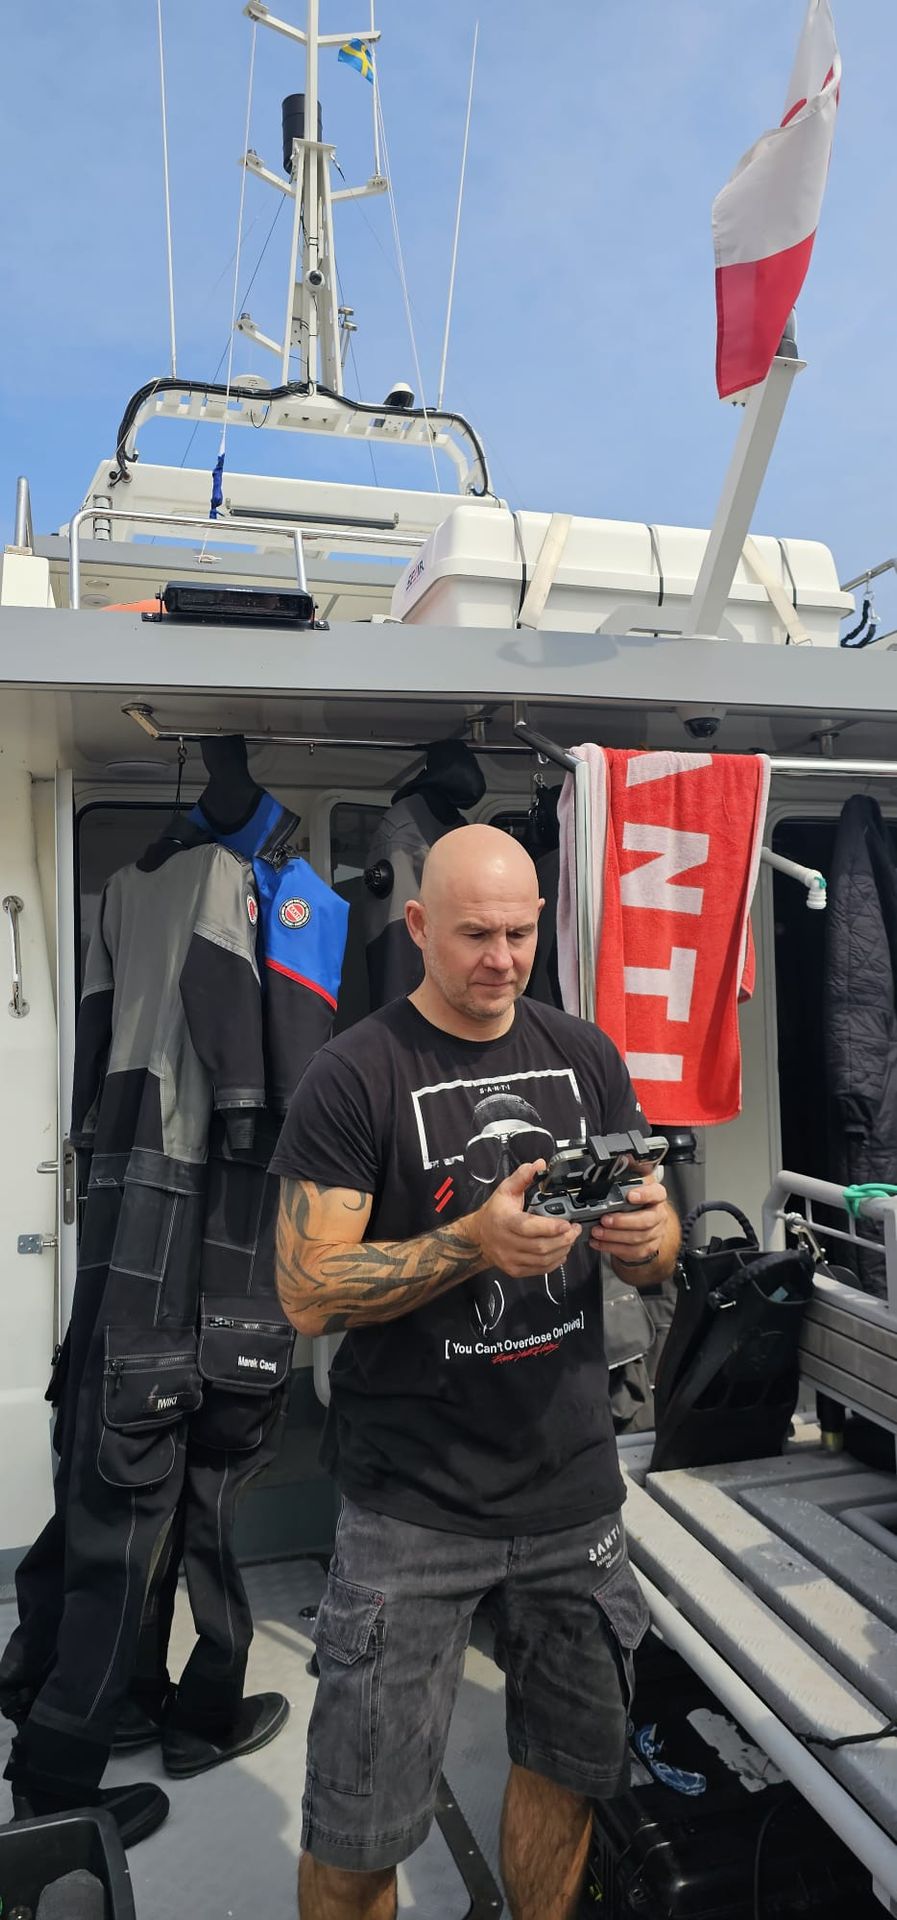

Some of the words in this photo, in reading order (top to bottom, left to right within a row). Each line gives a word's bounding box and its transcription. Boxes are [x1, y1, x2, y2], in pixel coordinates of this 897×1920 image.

[453, 1343, 472, 1354] You
[475, 1342, 503, 1354] Can't
[504, 1332, 552, 1351] Overdose
[553, 1327, 563, 1338] On
[563, 1318, 581, 1334] Diving
[588, 1523, 620, 1561] SANTI
